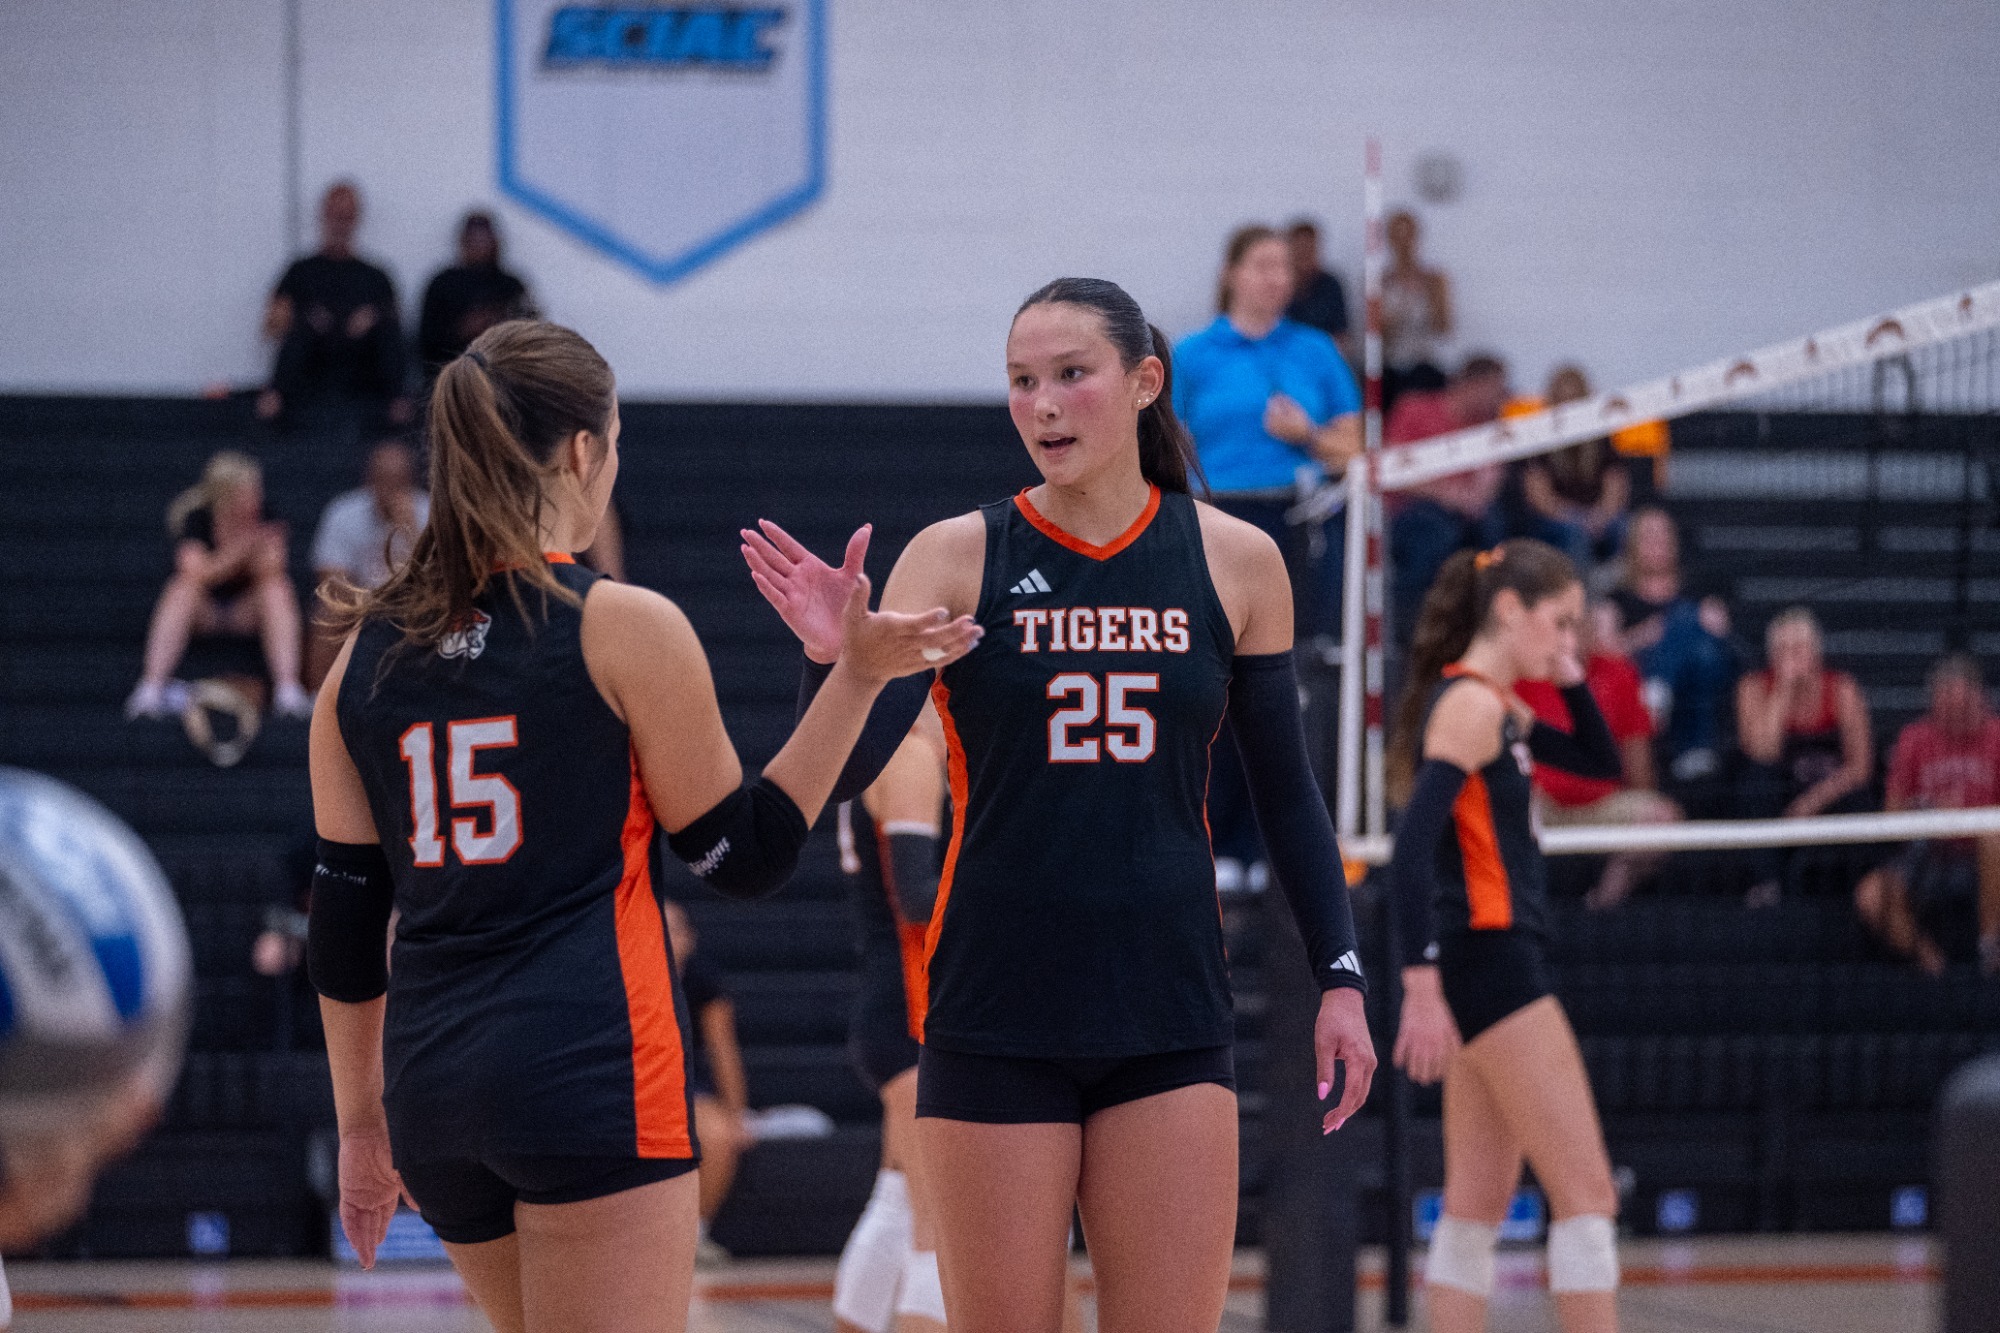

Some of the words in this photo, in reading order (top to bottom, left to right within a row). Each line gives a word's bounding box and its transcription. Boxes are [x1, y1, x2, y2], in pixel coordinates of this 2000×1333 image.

[1013, 606, 1191, 654] TIGERS
[1046, 672, 1160, 764] 25
[398, 714, 524, 869] 15
